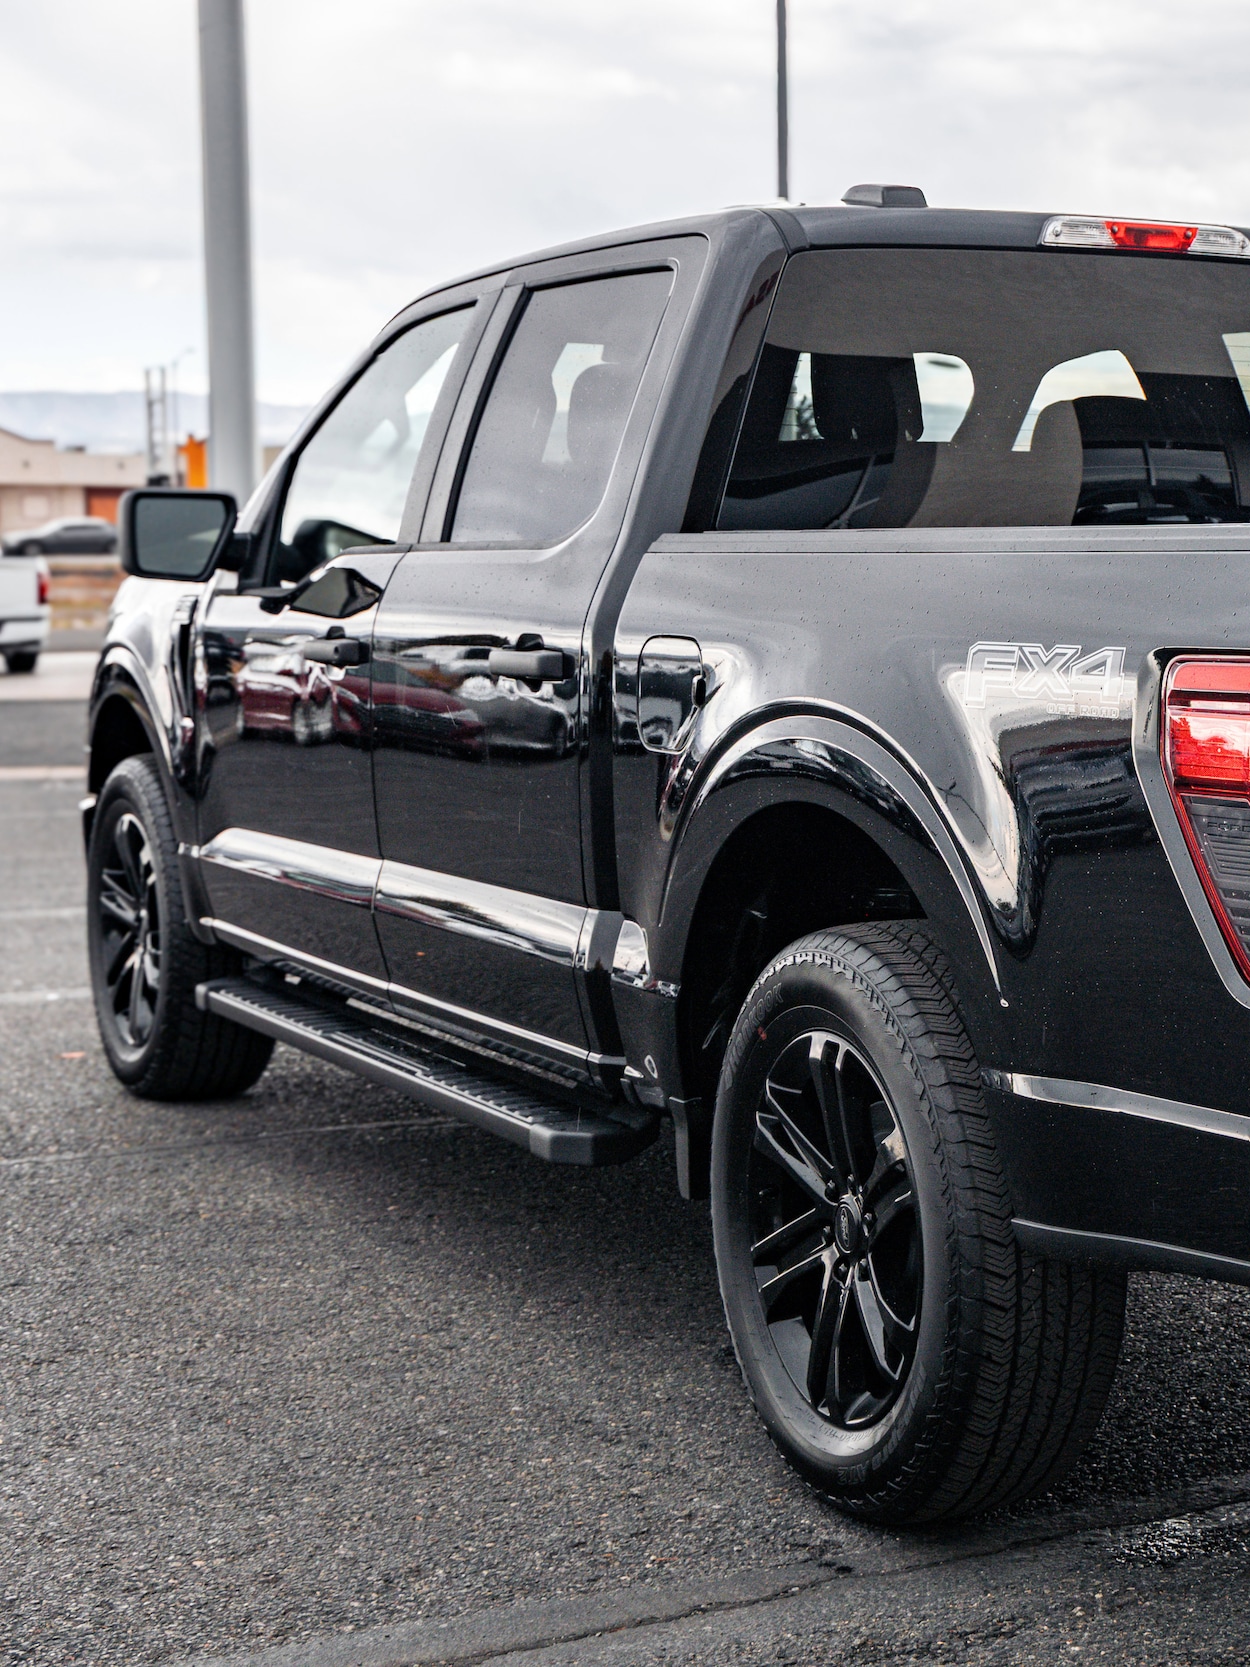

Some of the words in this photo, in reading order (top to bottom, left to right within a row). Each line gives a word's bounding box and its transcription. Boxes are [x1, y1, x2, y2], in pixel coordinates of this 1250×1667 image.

[963, 641, 1126, 708] FX4
[1046, 703, 1075, 716] OFF
[1079, 705, 1119, 719] ROAD
